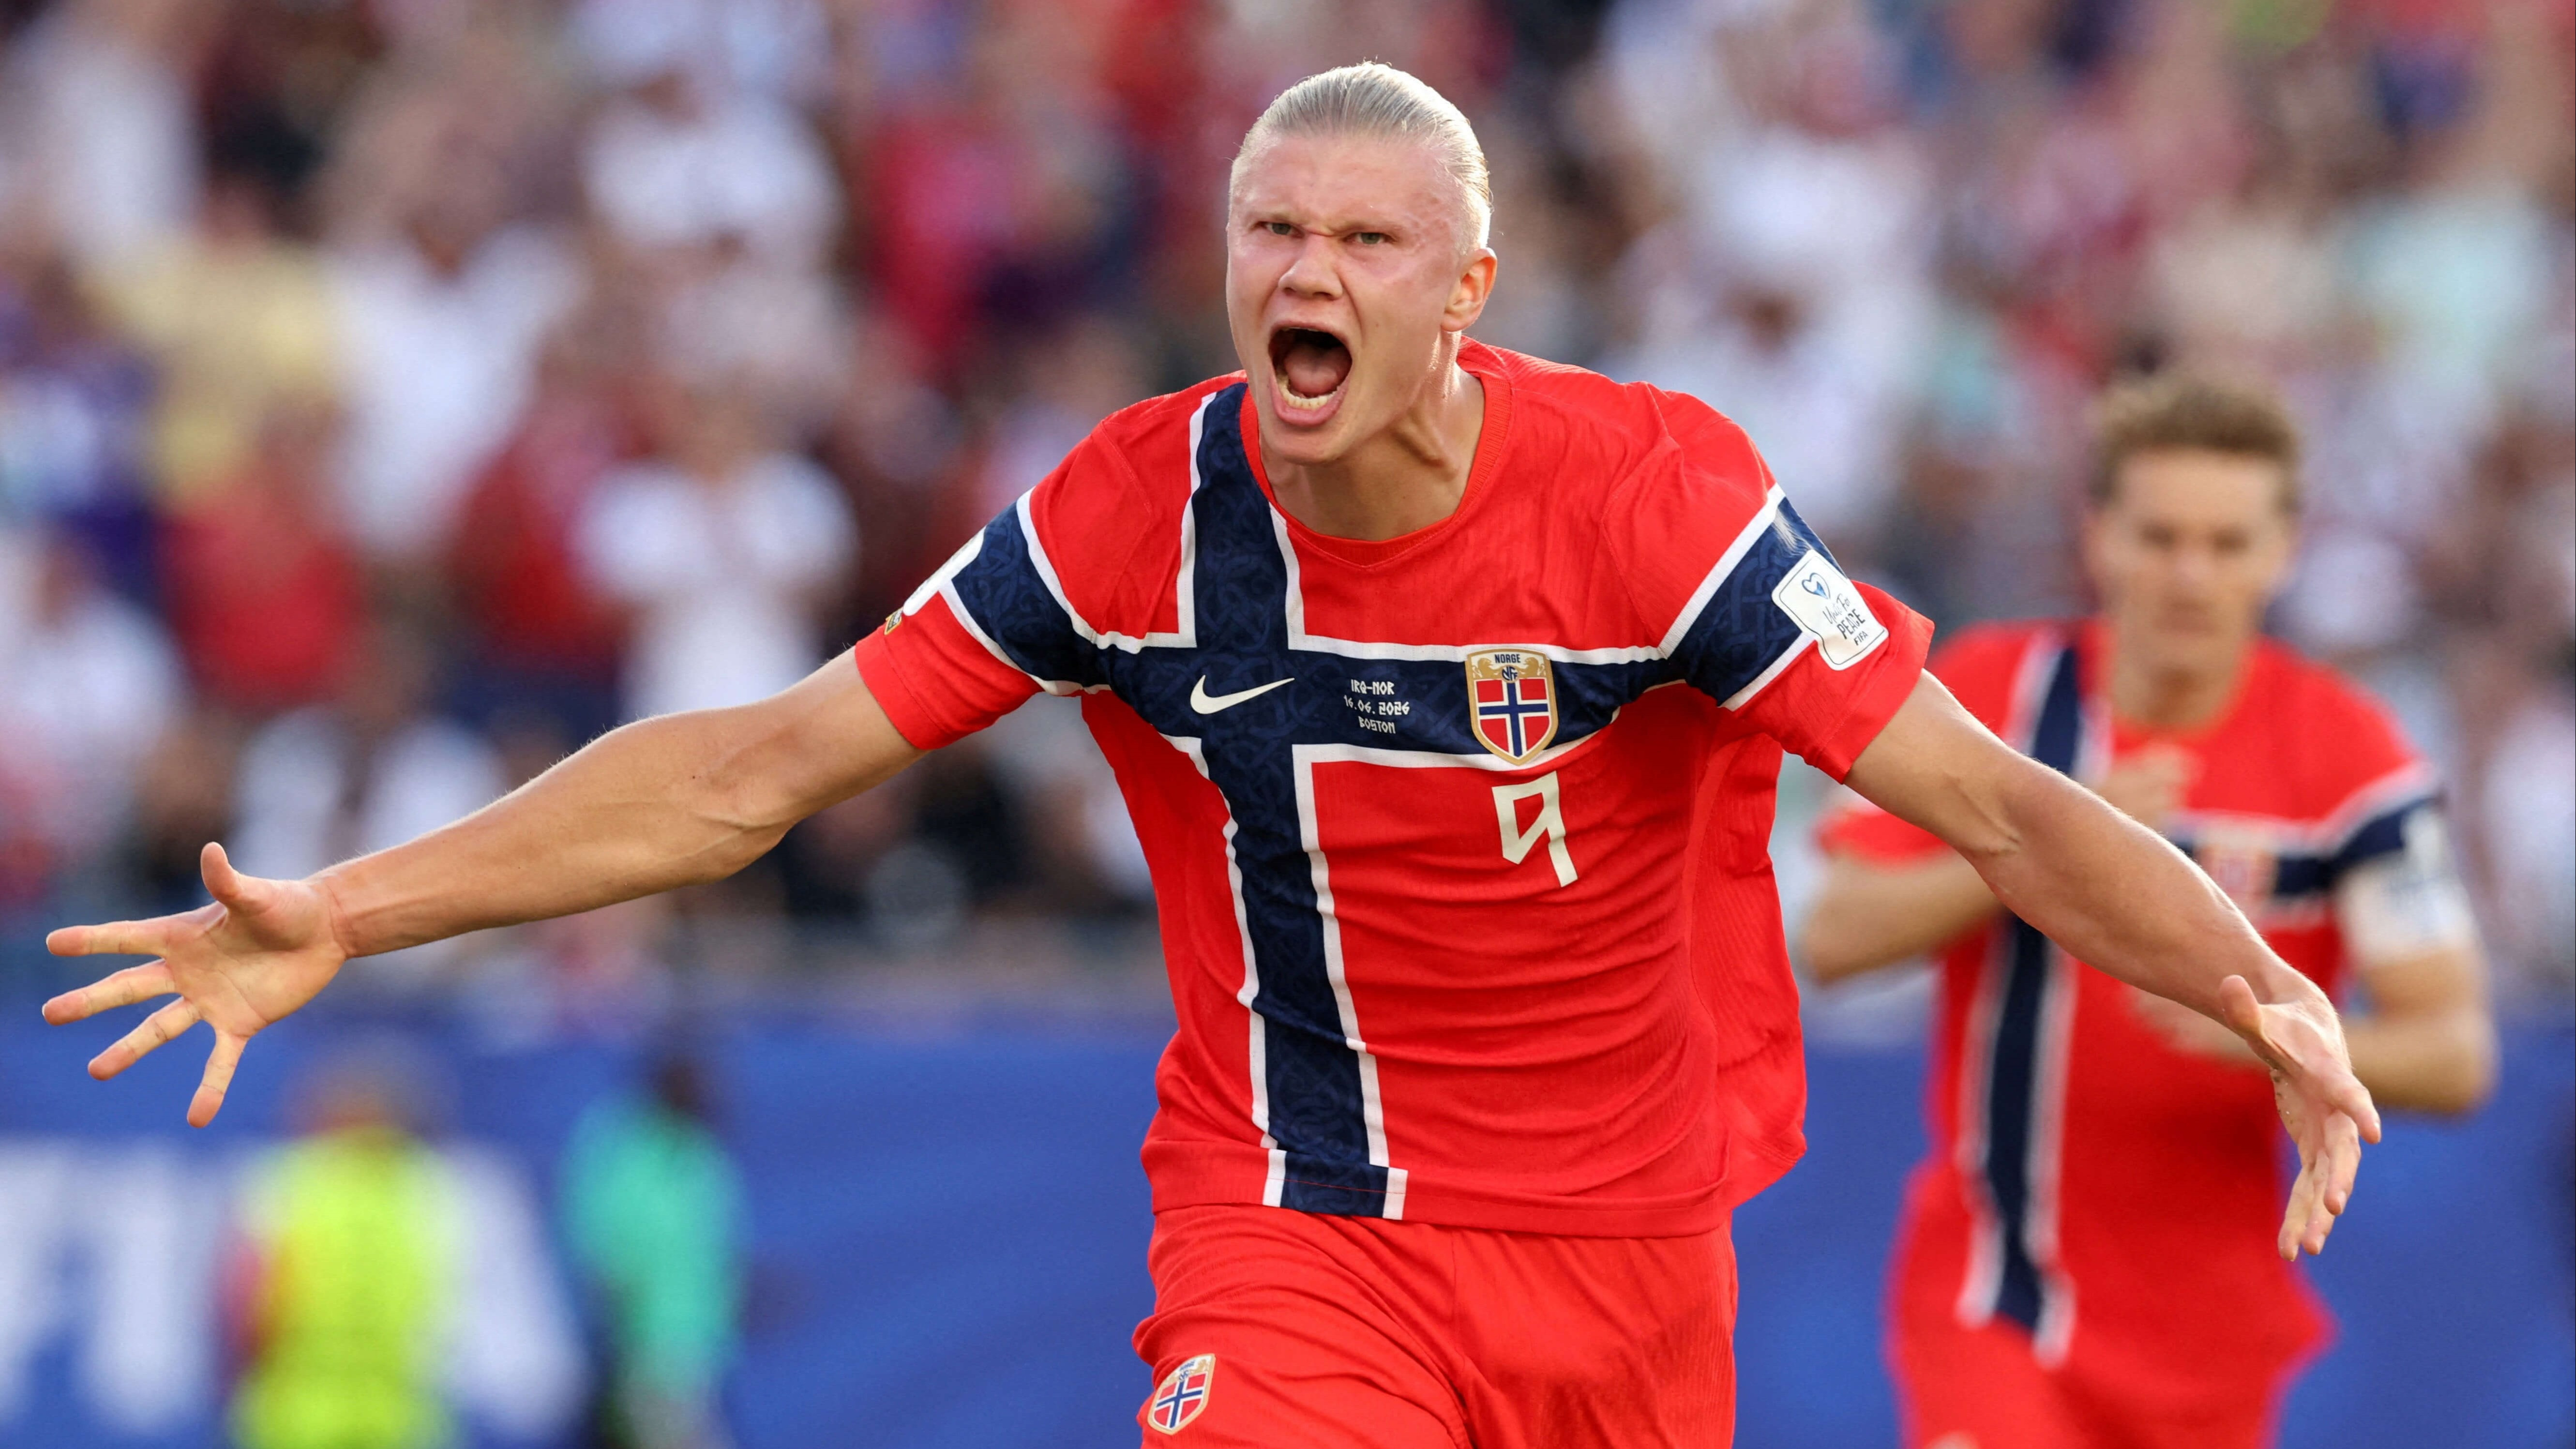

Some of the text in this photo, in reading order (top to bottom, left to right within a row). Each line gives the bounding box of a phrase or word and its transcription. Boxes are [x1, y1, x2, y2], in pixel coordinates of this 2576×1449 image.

[1836, 593, 1851, 612] For
[1837, 609, 1866, 639] PEACE
[1854, 631, 1868, 646] FIFA
[1494, 654, 1521, 664] NORGE
[1351, 679, 1395, 695] IRQ-NOR
[1358, 715, 1396, 734] BOSTON
[1491, 770, 1578, 888] 9
